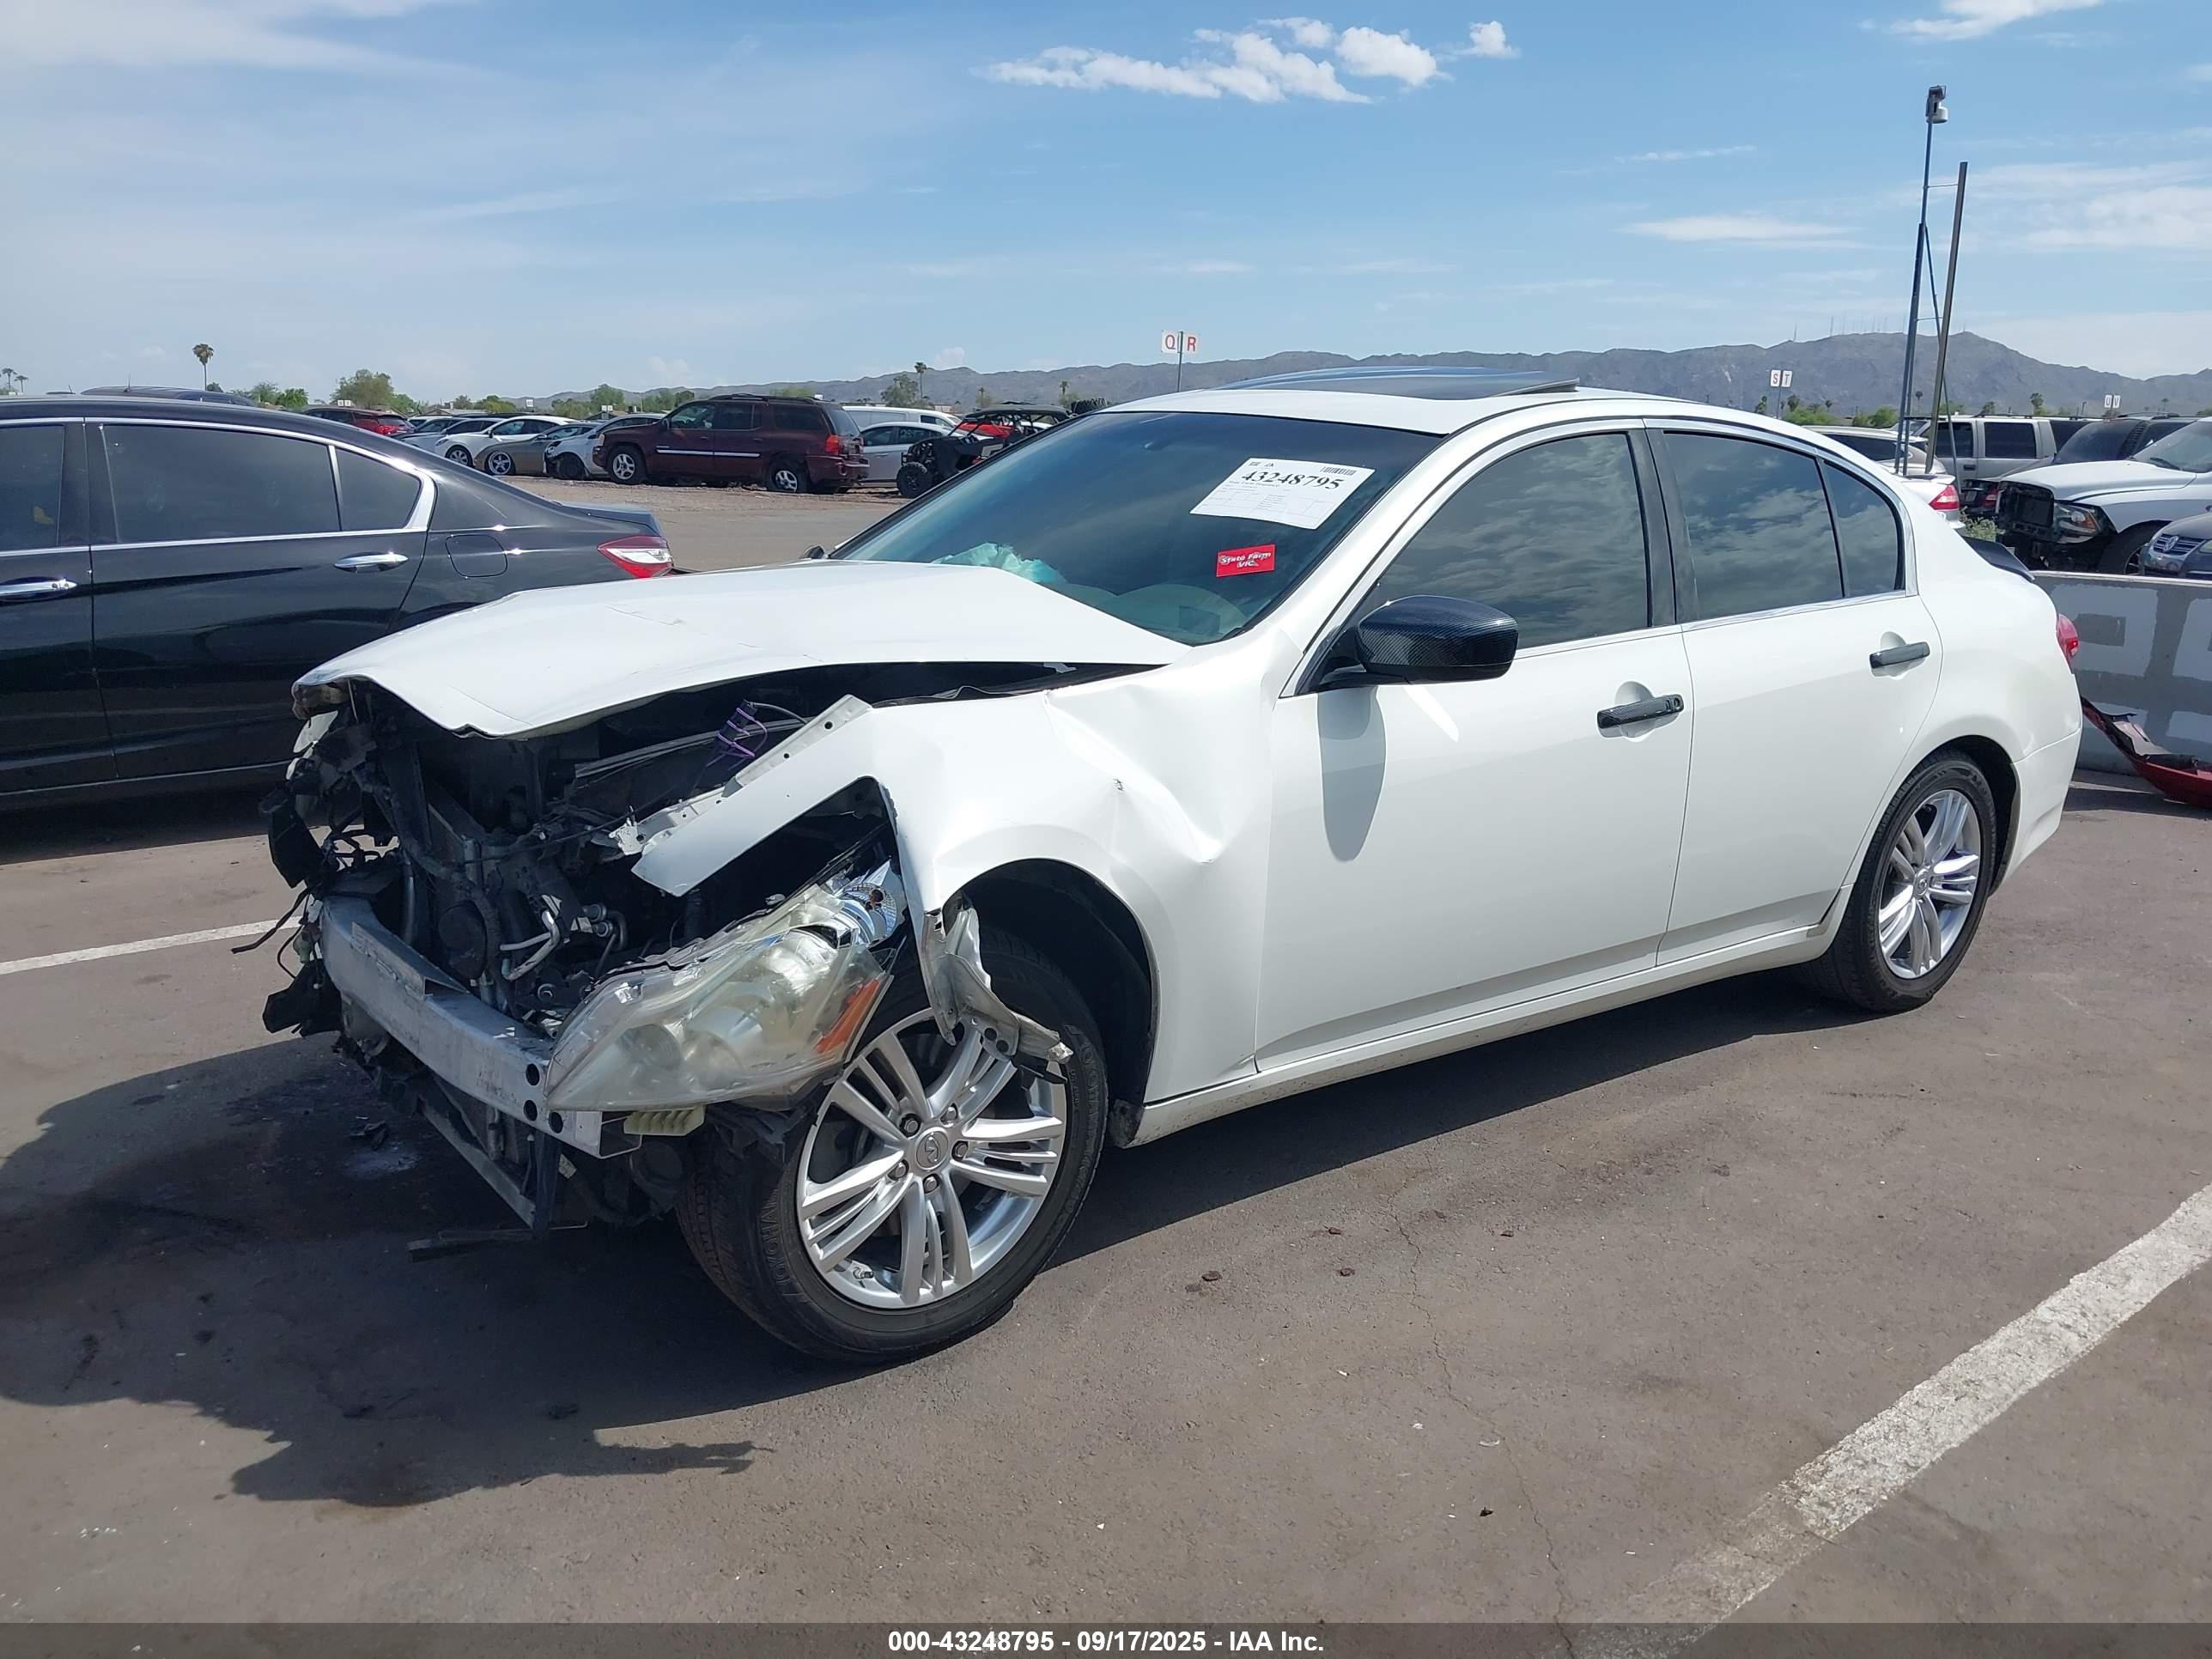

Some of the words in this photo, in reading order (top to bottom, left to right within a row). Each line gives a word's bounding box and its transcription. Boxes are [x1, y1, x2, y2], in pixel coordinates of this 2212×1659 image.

[1165, 334, 1176, 349] Q
[1187, 336, 1196, 351] R
[1772, 374, 1778, 384] S
[1784, 374, 1790, 386] T
[1242, 471, 1344, 489] 43248795
[1221, 555, 1245, 564] State
